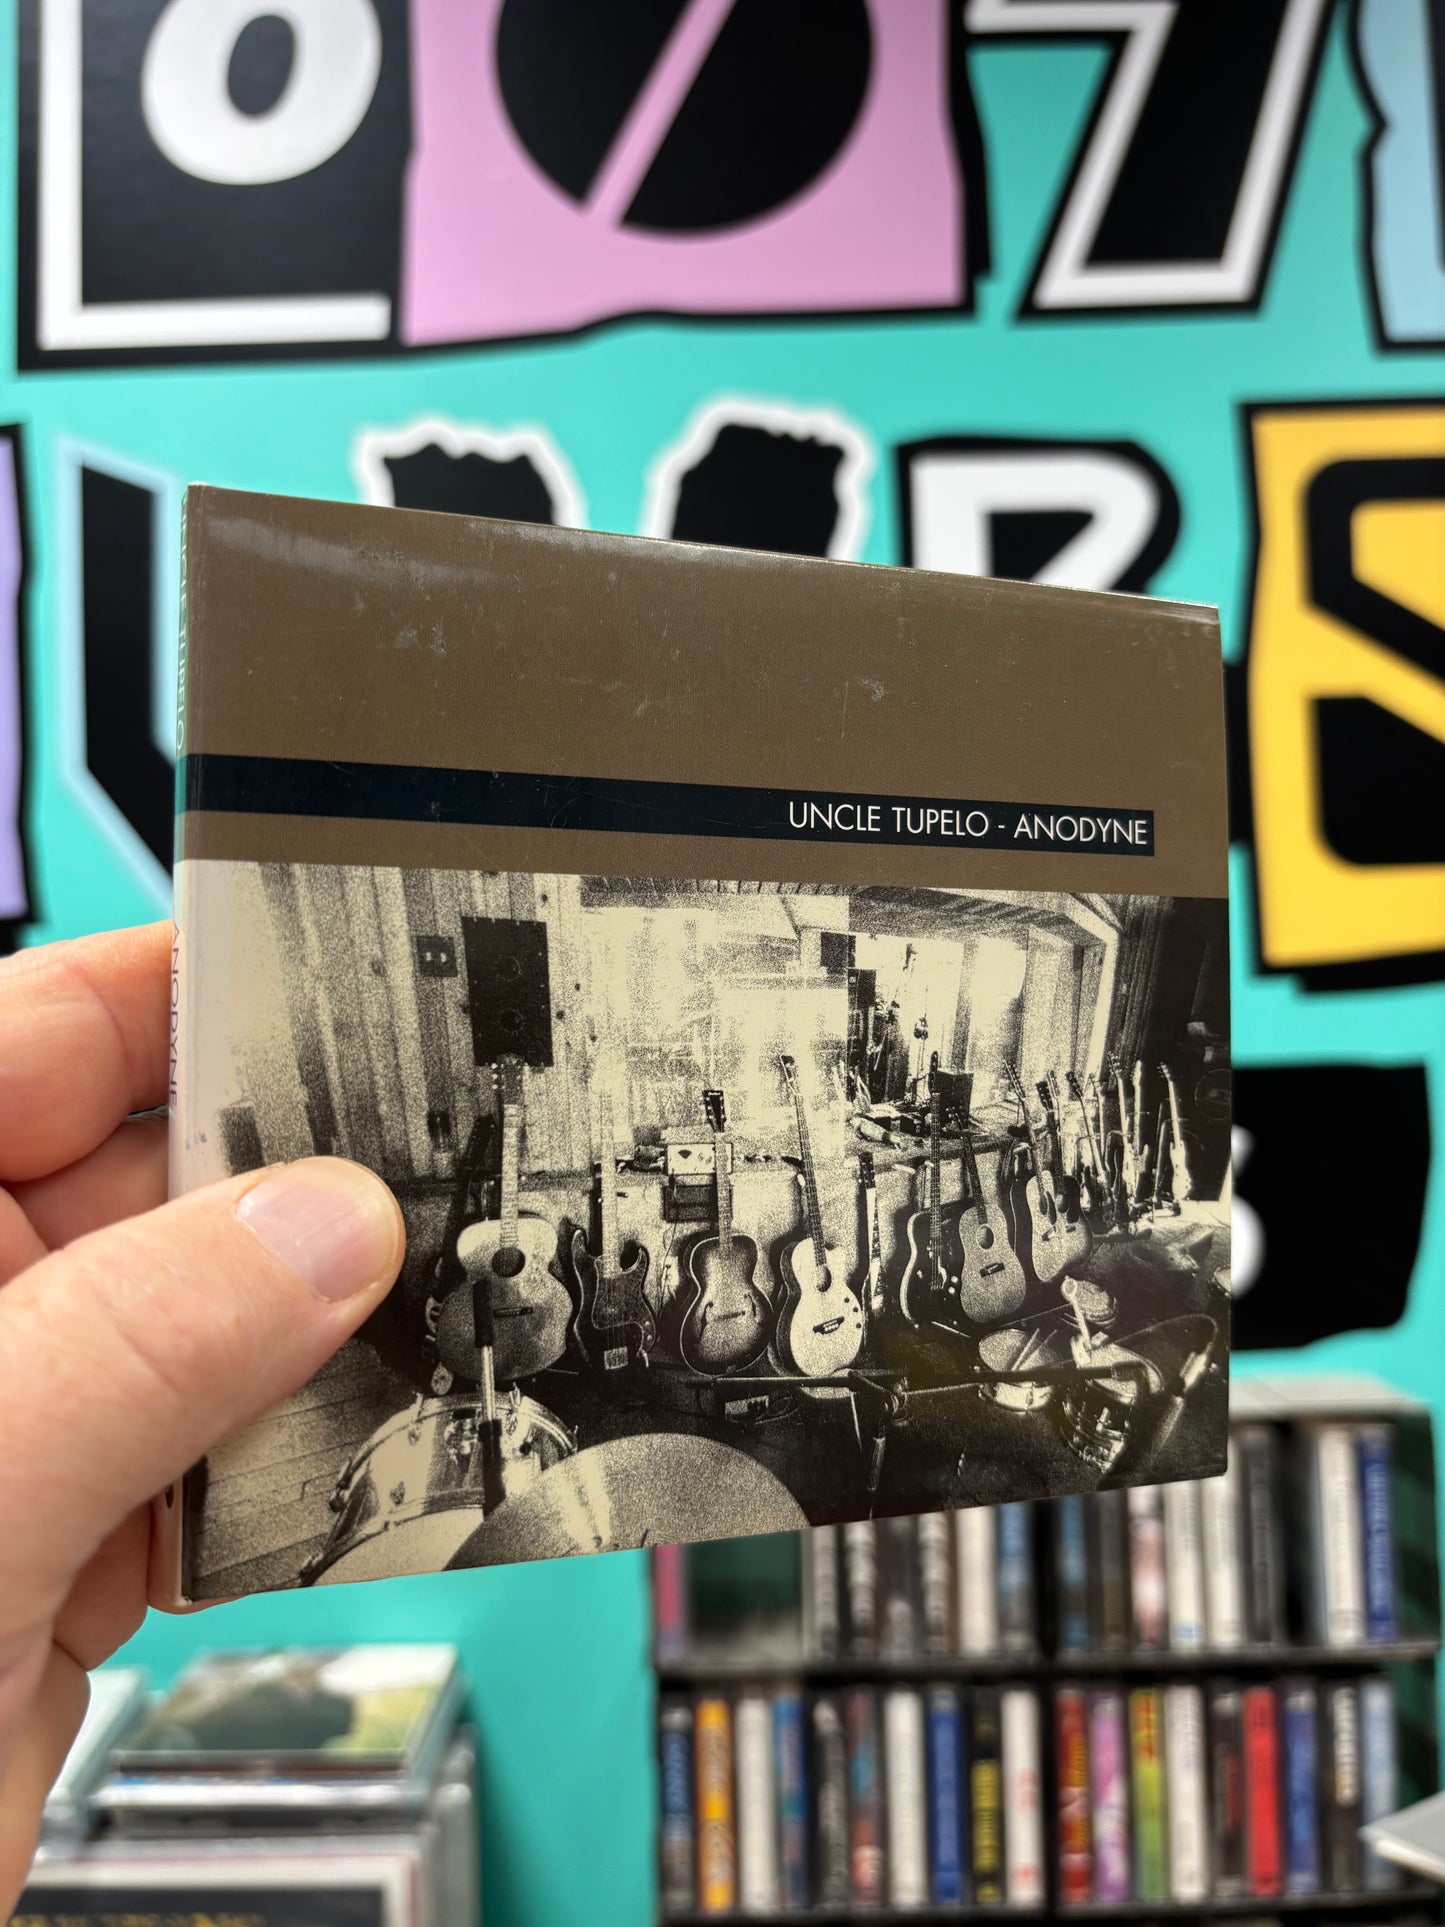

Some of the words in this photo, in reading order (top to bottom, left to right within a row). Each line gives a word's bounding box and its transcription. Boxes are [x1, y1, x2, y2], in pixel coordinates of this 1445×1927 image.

[789, 801, 881, 832] UNCLE
[891, 806, 989, 837] TUPELO
[1013, 813, 1148, 845] ANODYNE
[170, 922, 180, 1107] ANODYNE
